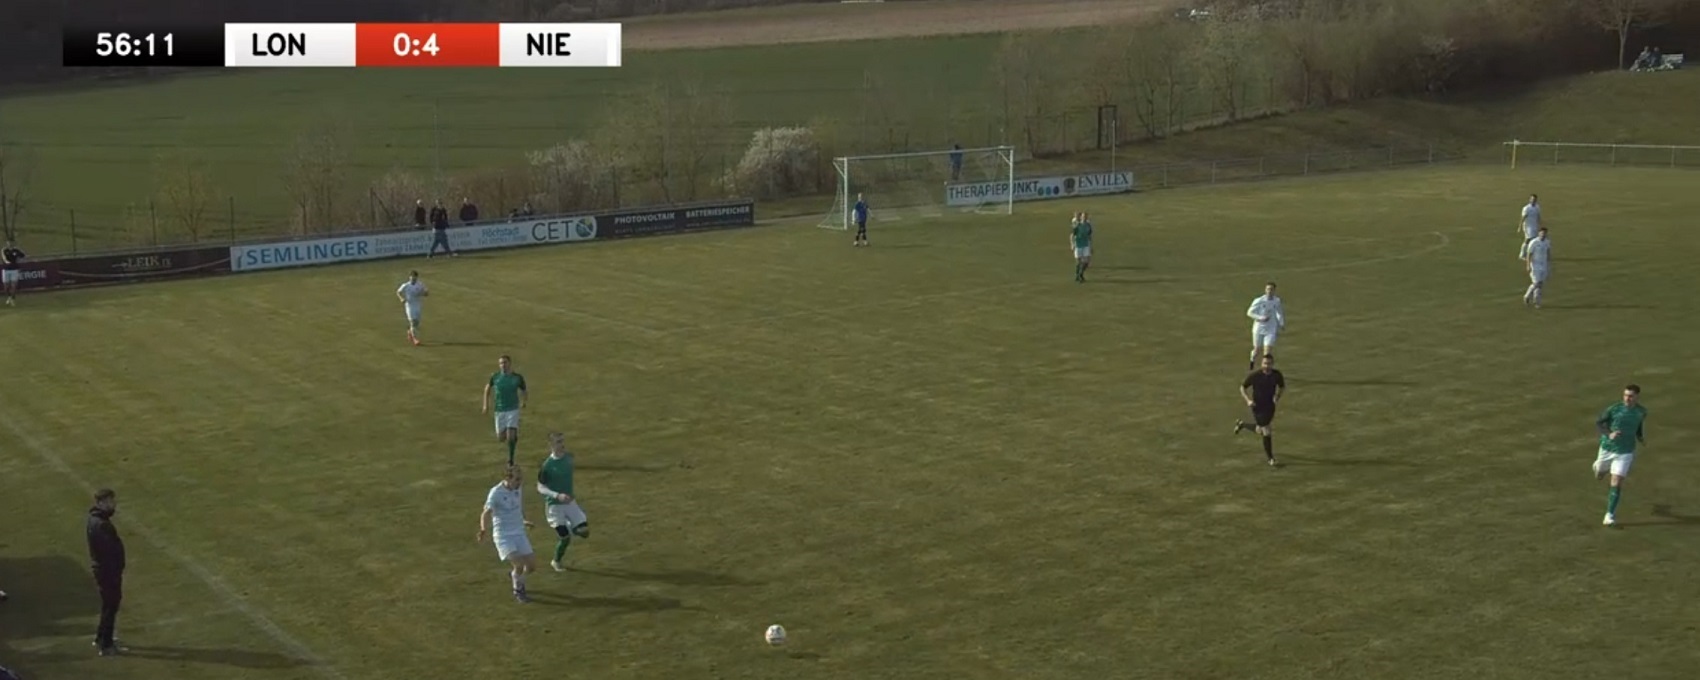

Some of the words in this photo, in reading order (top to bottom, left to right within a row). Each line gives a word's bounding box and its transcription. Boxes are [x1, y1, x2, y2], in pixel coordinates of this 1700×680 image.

[1077, 172, 1130, 189] ENVILEX
[948, 180, 1040, 200] THERAPIEPUNKT
[614, 211, 675, 225] PHOTOVOLTAIK
[685, 205, 750, 219] BATTERIESPEICHER
[531, 219, 573, 242] CET
[246, 239, 369, 266] SEMLINGER
[18, 270, 47, 280] ERGIE
